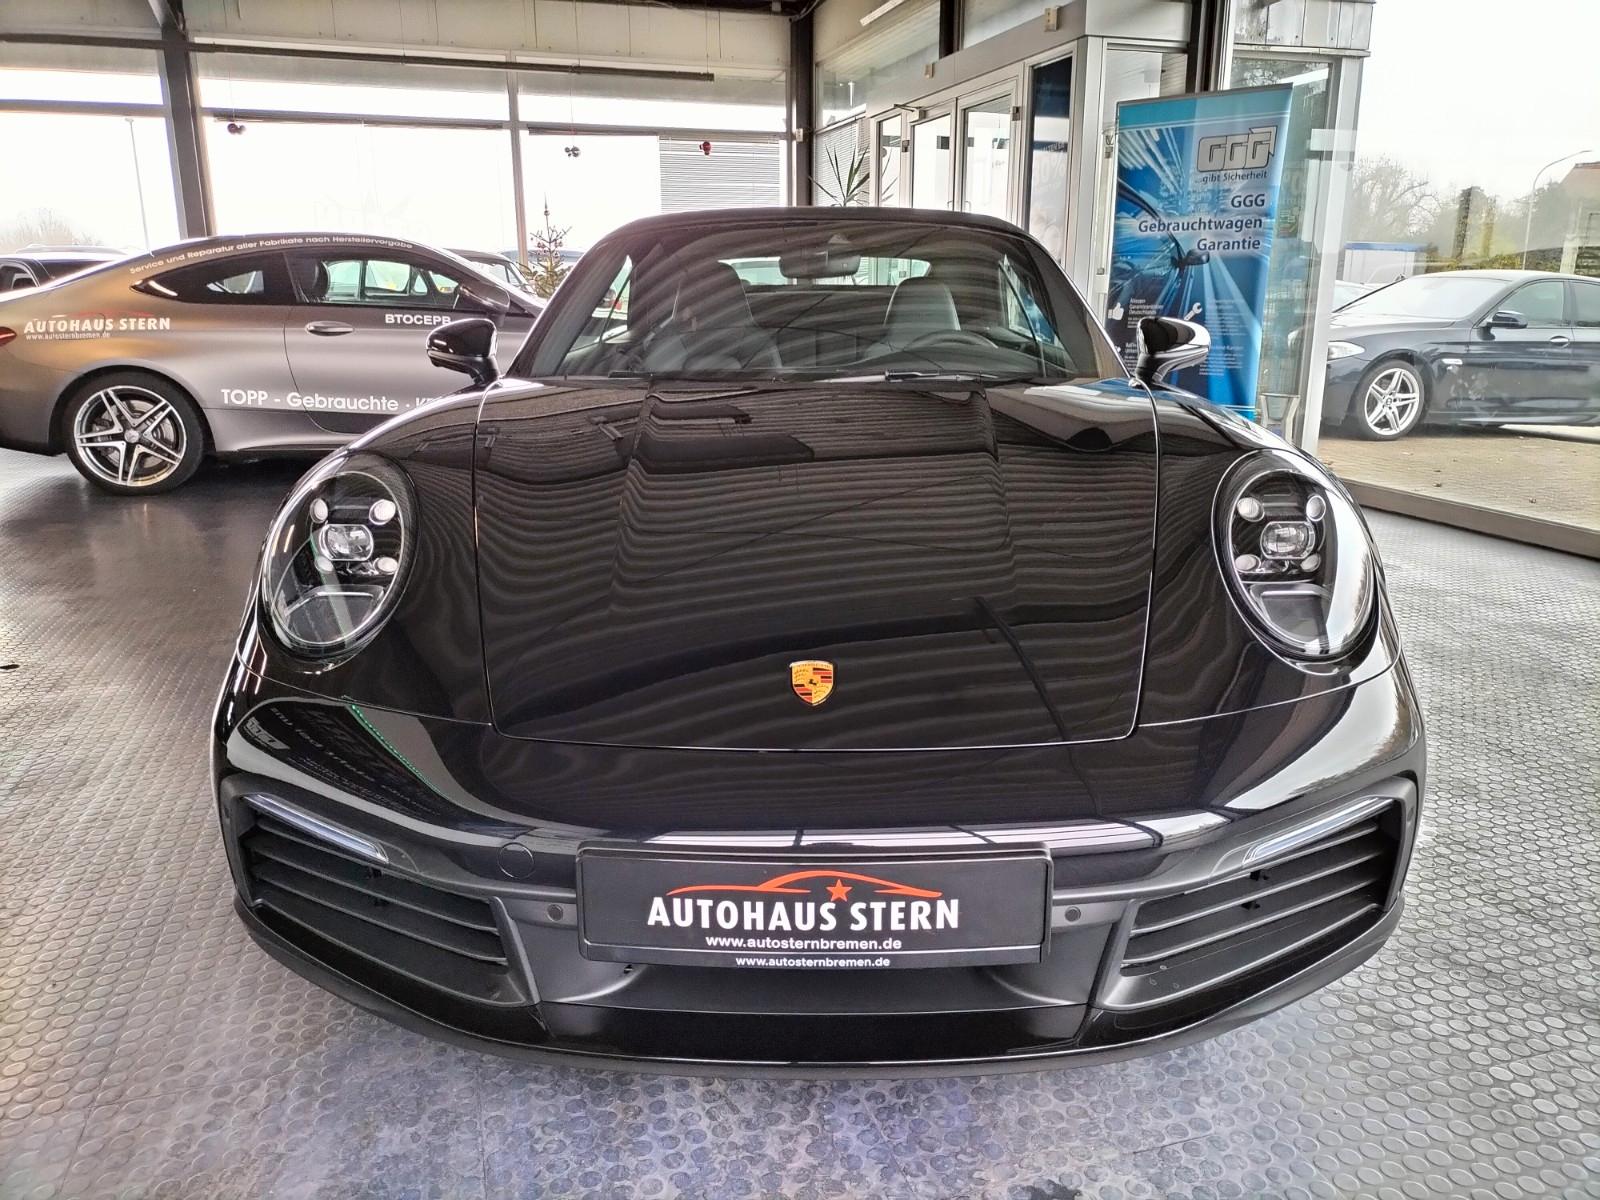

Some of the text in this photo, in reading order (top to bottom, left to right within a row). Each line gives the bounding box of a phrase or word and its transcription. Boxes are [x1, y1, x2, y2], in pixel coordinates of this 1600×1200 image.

[1197, 125, 1278, 172] GGG
[1223, 170, 1267, 182] Sicherheit
[1230, 193, 1265, 208] GGG
[1138, 217, 1263, 233] Gebrauchtwagen
[1197, 236, 1261, 251] Garantie
[130, 236, 413, 274] Service und Reparatur aller Fabrikate nach Herstellervorgabe
[23, 317, 171, 334] AUTOHAUS STERN
[25, 331, 111, 342] www.autosternbremen.de
[220, 388, 269, 406] TOPP
[286, 391, 399, 412] Gebrauchte
[647, 896, 959, 932] AUTOHAUS STERN
[705, 936, 903, 951] www.autosternbremen.de
[735, 957, 891, 968] www.autosternbremen.de
